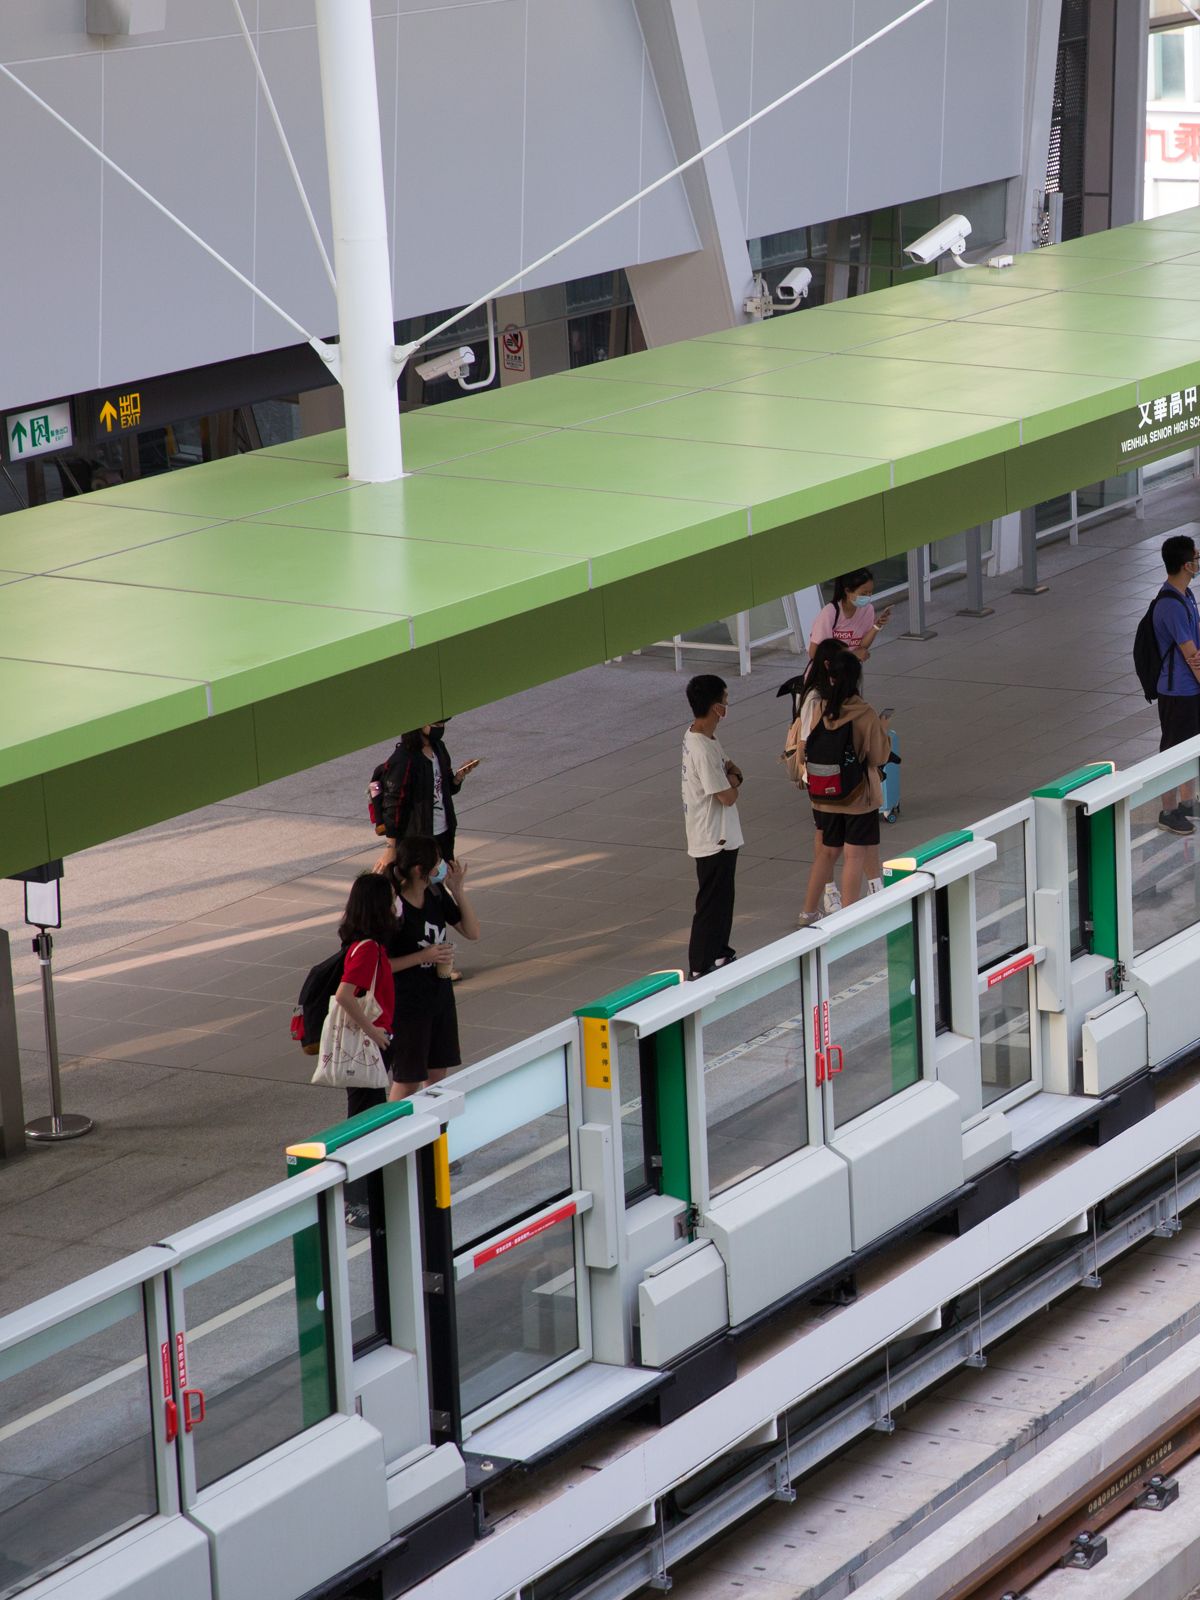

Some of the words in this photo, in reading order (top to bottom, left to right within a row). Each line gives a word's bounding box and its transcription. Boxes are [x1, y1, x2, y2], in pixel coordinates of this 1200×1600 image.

[119, 392, 141, 416] 出口
[120, 413, 141, 429] EXIT
[1121, 434, 1149, 453] WENHUA
[1149, 428, 1173, 443] SENIOR
[1173, 419, 1189, 434] HIGH
